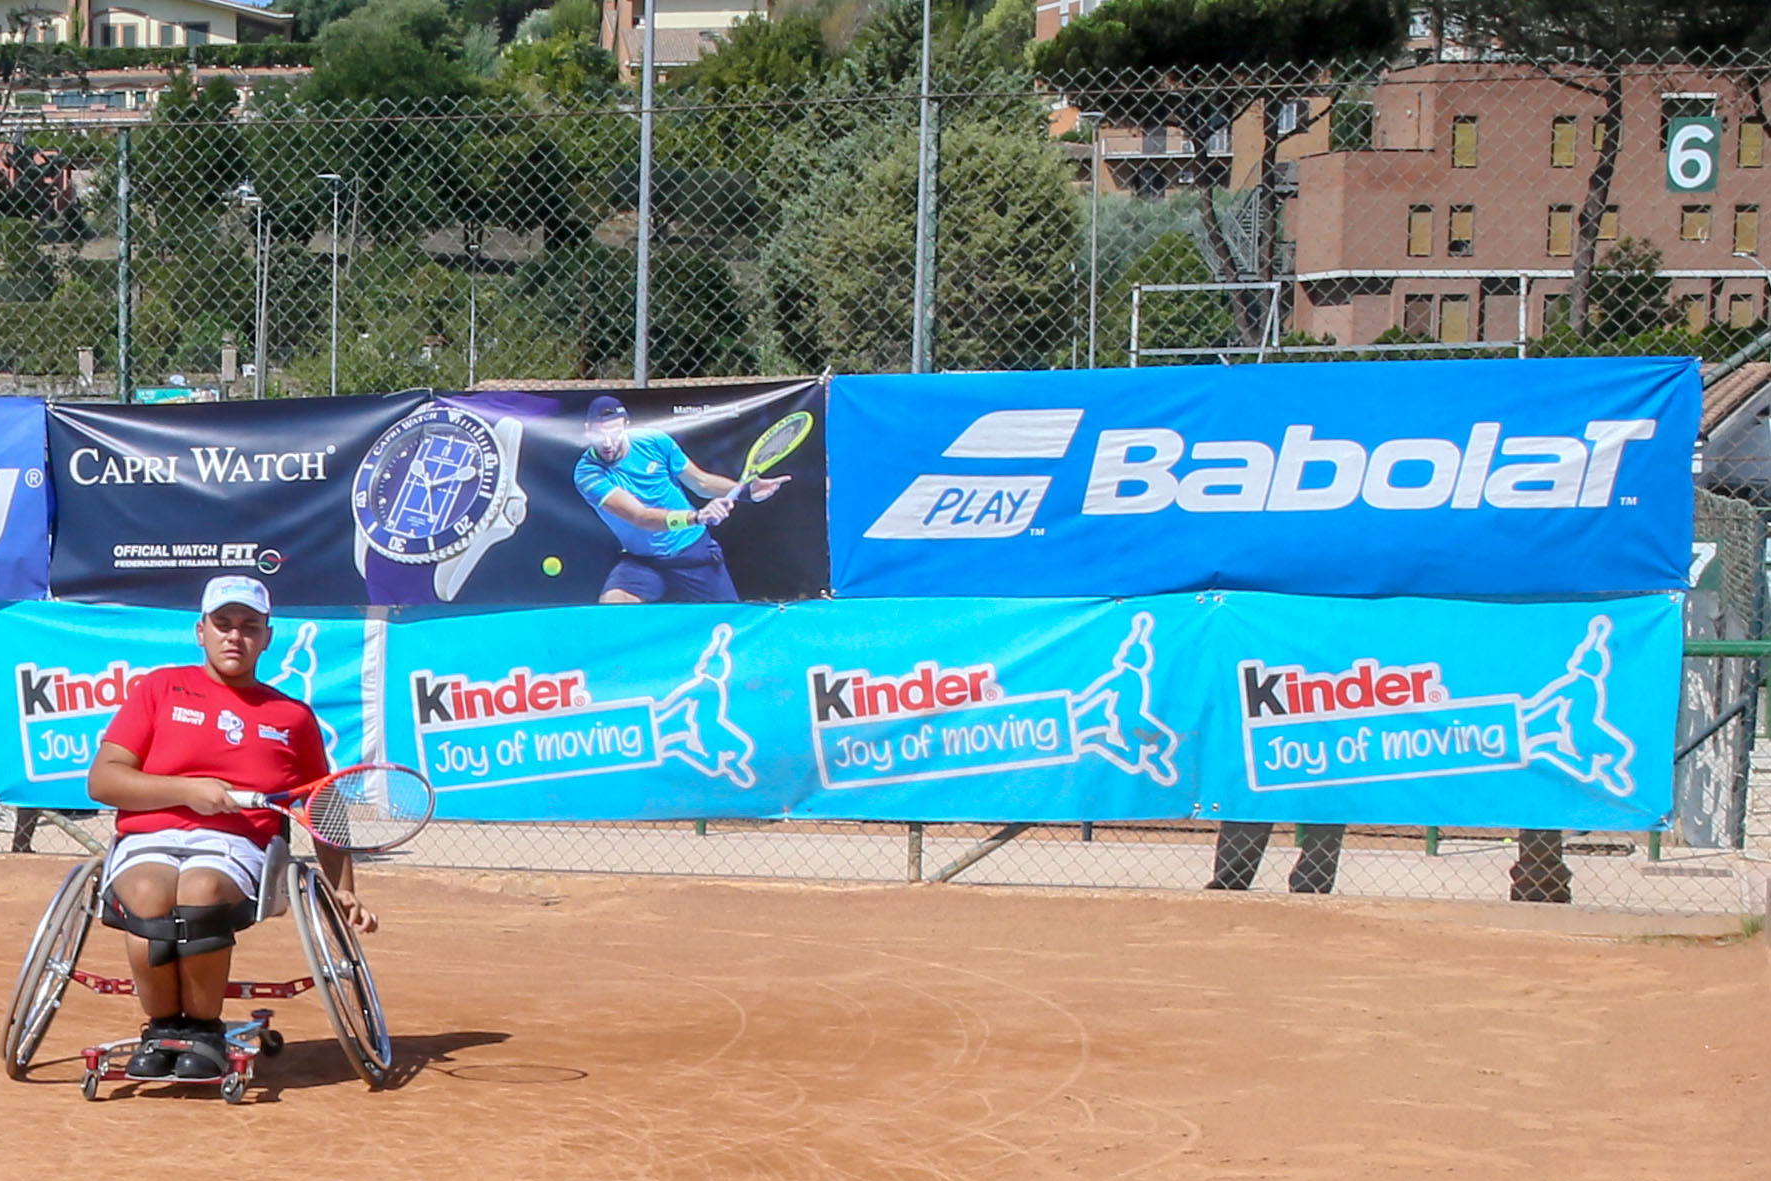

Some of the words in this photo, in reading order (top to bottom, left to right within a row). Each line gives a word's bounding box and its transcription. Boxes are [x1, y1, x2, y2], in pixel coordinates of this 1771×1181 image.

[1669, 124, 1714, 188] 6
[923, 487, 1030, 527] PLAY
[114, 545, 170, 557] OFFICIAL
[172, 544, 218, 557] WATCH
[221, 543, 259, 559] FIT
[114, 559, 177, 568] FEDERAZIONE
[178, 559, 220, 568] ITALIANA
[39, 729, 89, 764] Joy
[435, 741, 490, 777] Joy
[496, 730, 527, 766] of
[534, 721, 643, 761] moving
[835, 735, 893, 772] Joy
[900, 724, 933, 761] of
[941, 714, 1060, 756] moving
[1264, 735, 1328, 775] Joy
[1336, 726, 1372, 764] of
[1381, 719, 1507, 758] moving
